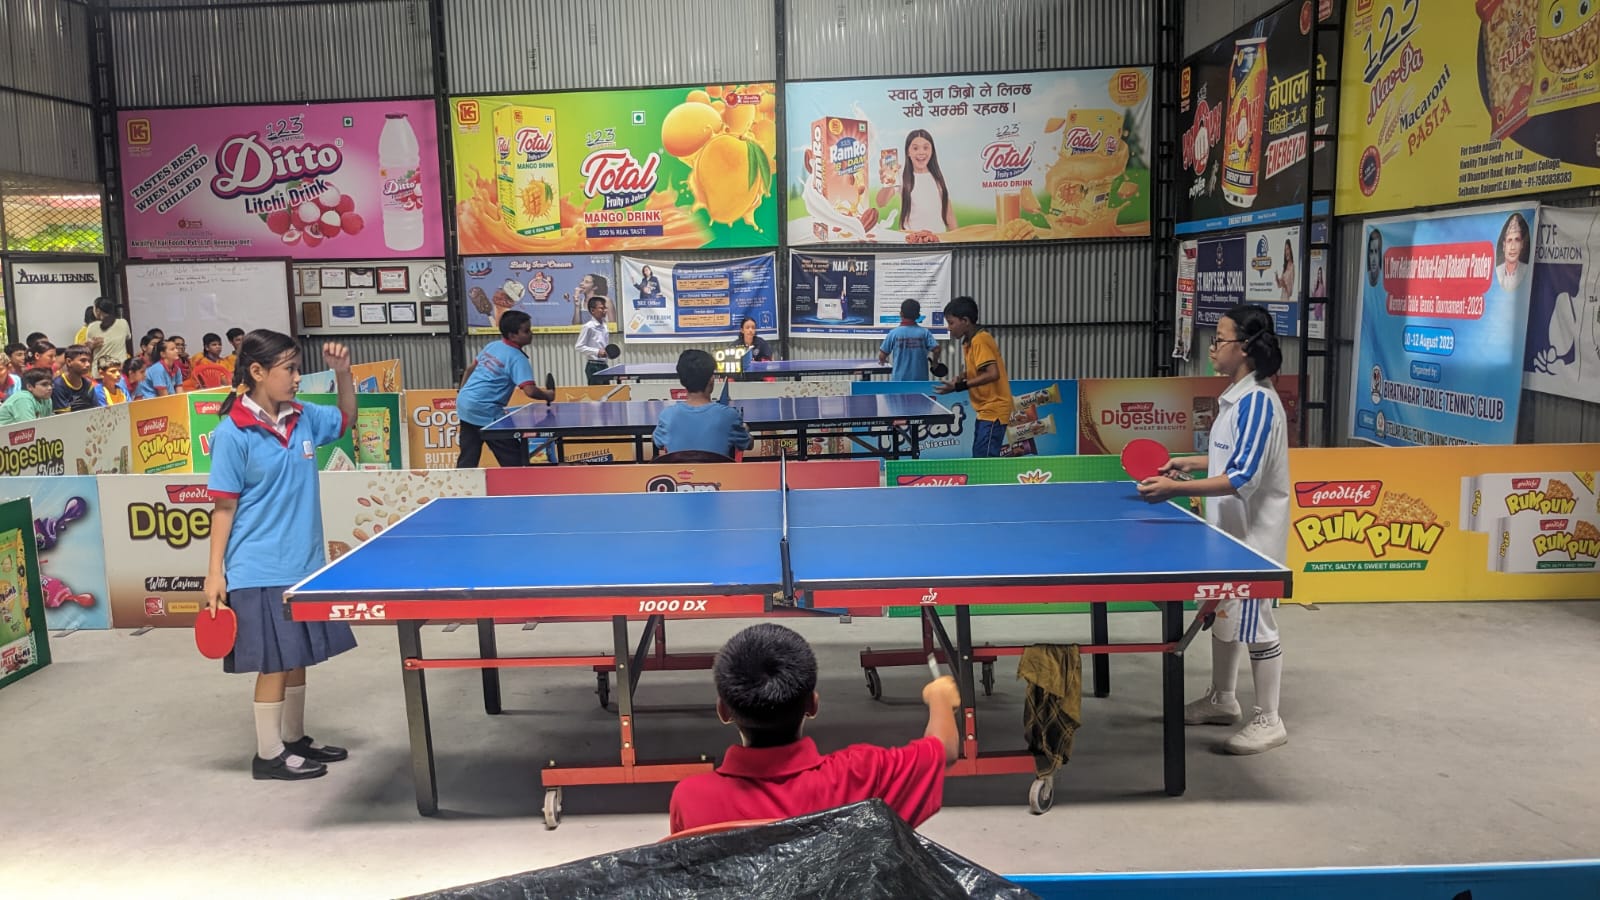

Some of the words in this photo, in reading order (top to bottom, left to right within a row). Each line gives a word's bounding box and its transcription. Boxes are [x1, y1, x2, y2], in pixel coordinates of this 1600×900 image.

[922, 88, 945, 103] जुन
[978, 82, 993, 98] ले
[997, 82, 1033, 97] लिन्छ
[1399, 63, 1451, 133] Macaroni
[266, 116, 304, 138] 123
[586, 128, 616, 144] 123
[995, 123, 1021, 138] 123
[1407, 96, 1452, 156] PASTA
[516, 128, 553, 154] Total
[1066, 128, 1102, 149] Total
[215, 134, 339, 193] Ditto
[982, 142, 1033, 171] Total
[131, 166, 171, 198] TASTES
[170, 147, 198, 171] BEST
[135, 185, 168, 211] WHEN
[167, 156, 208, 189] SERVED
[582, 150, 660, 196] Total
[383, 180, 416, 195] Ditto
[982, 180, 1008, 188] MANGO
[1010, 180, 1033, 188] DRINK
[158, 178, 202, 213] CHILLED
[244, 192, 287, 214] Litchi
[288, 178, 329, 206] Drink
[606, 195, 625, 208] Fruity
[584, 212, 624, 223] MANGO
[627, 211, 661, 221] DRINK
[60, 273, 94, 282] TENNIS
[1420, 333, 1438, 350] August
[1440, 336, 1454, 350] 2023
[1383, 380, 1420, 406] BIRATNAGAR
[1422, 388, 1443, 410] TABLE
[1444, 392, 1475, 417] TENNIS
[1476, 397, 1504, 421] CLUB
[1101, 408, 1187, 430] Digestive
[138, 434, 168, 462] RUM
[164, 438, 191, 461] PUM
[1312, 484, 1372, 505] goodlife
[1504, 490, 1546, 516] RUM
[1540, 497, 1576, 514] PUM
[1294, 510, 1377, 551] RUM
[1364, 522, 1443, 558] PUM
[1533, 531, 1573, 557] RUM
[1566, 538, 1600, 560] PUM
[1388, 562, 1421, 570] BISCUITS
[1194, 582, 1250, 600] STAG
[328, 602, 386, 621] STAG
[638, 600, 680, 613] 1000
[682, 600, 708, 612] DX
